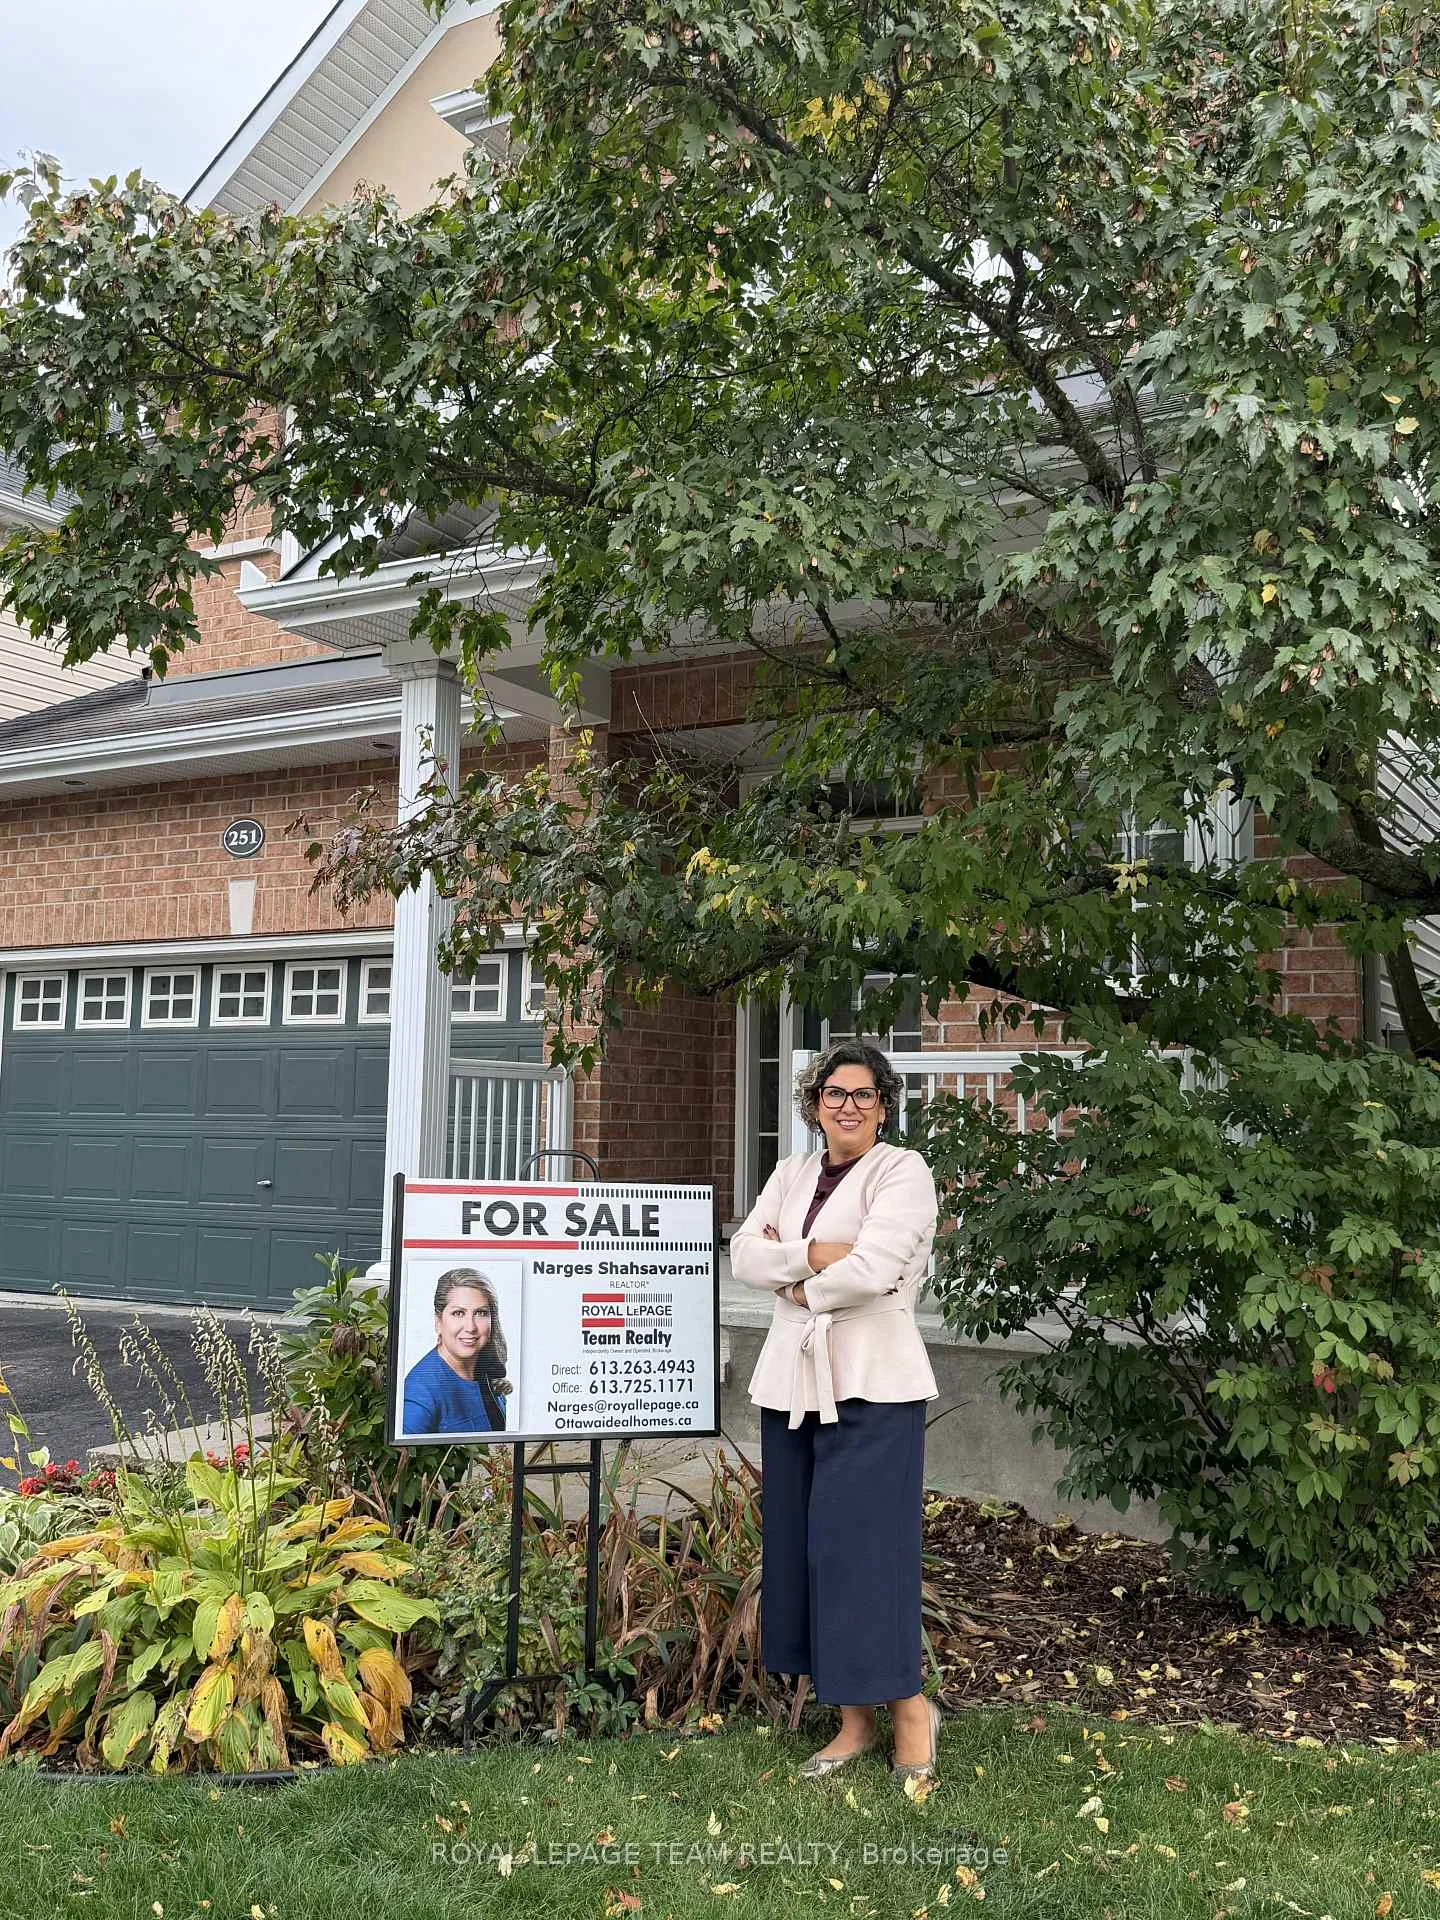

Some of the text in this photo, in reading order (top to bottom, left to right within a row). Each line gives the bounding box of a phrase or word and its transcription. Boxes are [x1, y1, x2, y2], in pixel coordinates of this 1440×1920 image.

[229, 829, 258, 846] 251
[461, 1200, 660, 1238] FOR SALE
[533, 1261, 710, 1277] Narges Shahsavarani
[582, 1305, 623, 1316] ROYAL
[582, 1328, 672, 1348] Team Realty
[551, 1359, 695, 1376] Direct: 613.263.4943
[552, 1378, 693, 1394] Office: 613.725.1171
[547, 1399, 699, 1415] Narges@royallepage.ca
[555, 1415, 692, 1429] Ottawaidealhomes.ca
